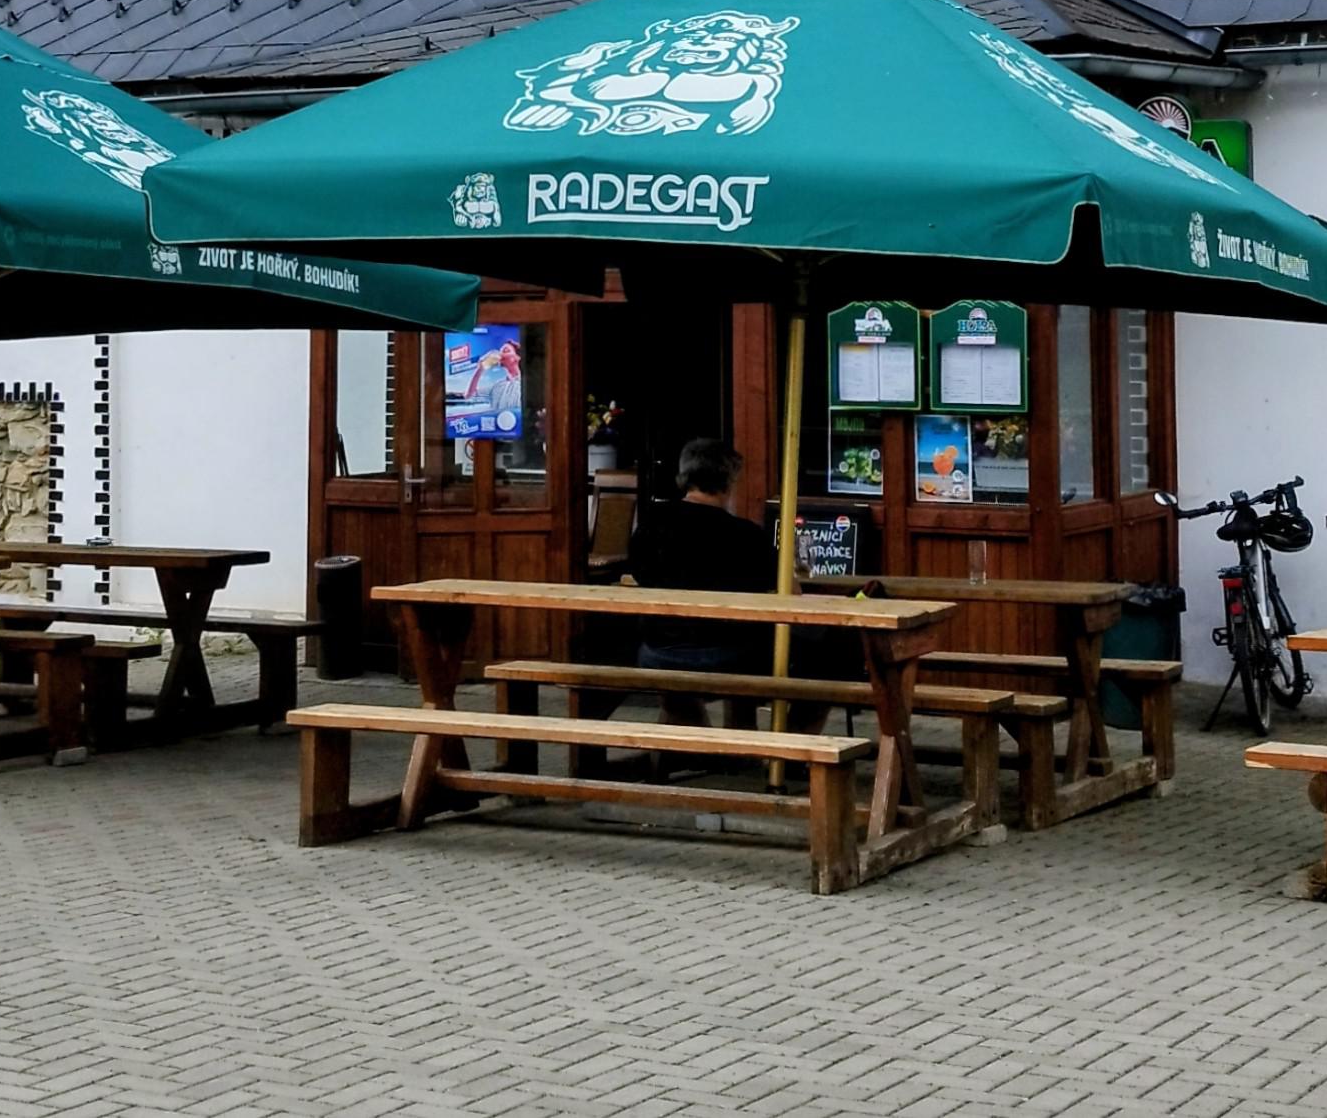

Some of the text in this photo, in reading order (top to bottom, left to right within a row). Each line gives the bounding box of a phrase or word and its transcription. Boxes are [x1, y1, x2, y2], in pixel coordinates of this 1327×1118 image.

[528, 172, 770, 232] RADEGAST
[1216, 228, 1241, 261] ŽIVOT
[240, 250, 254, 271] JE
[257, 252, 301, 282] HOŘKÝ.
[304, 264, 359, 293] BOHUDÍK!
